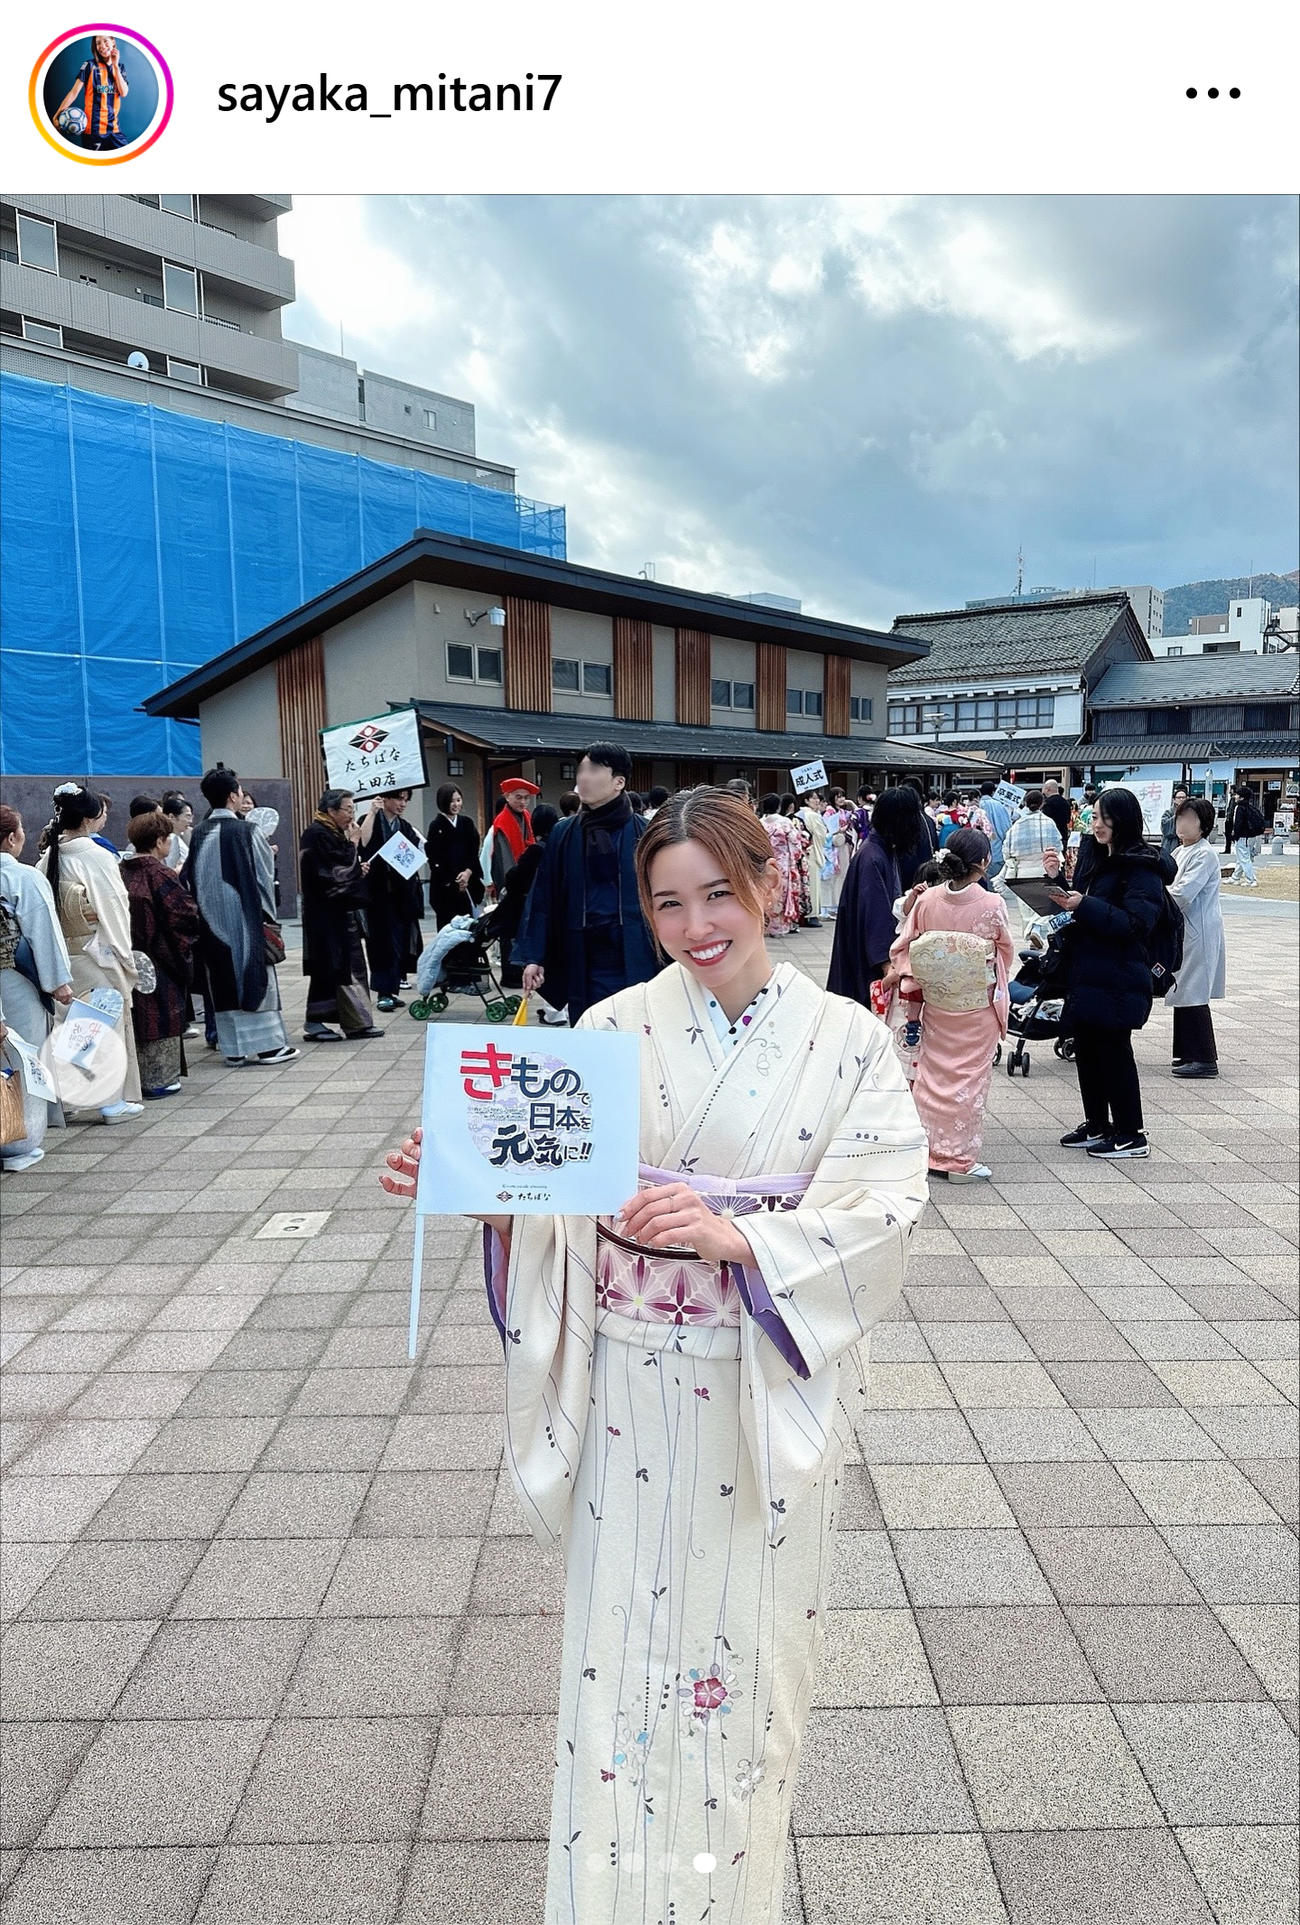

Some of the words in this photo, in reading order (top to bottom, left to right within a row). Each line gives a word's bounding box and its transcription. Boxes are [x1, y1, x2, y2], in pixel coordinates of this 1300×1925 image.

[345, 747, 401, 773] たちばな
[356, 771, 396, 793] 上田店
[795, 769, 824, 788] 成人式
[997, 787, 1022, 804] 卒業式
[460, 1043, 591, 1105] きもので
[530, 1102, 592, 1131] 日本を
[489, 1124, 593, 1166] 元気に!!
